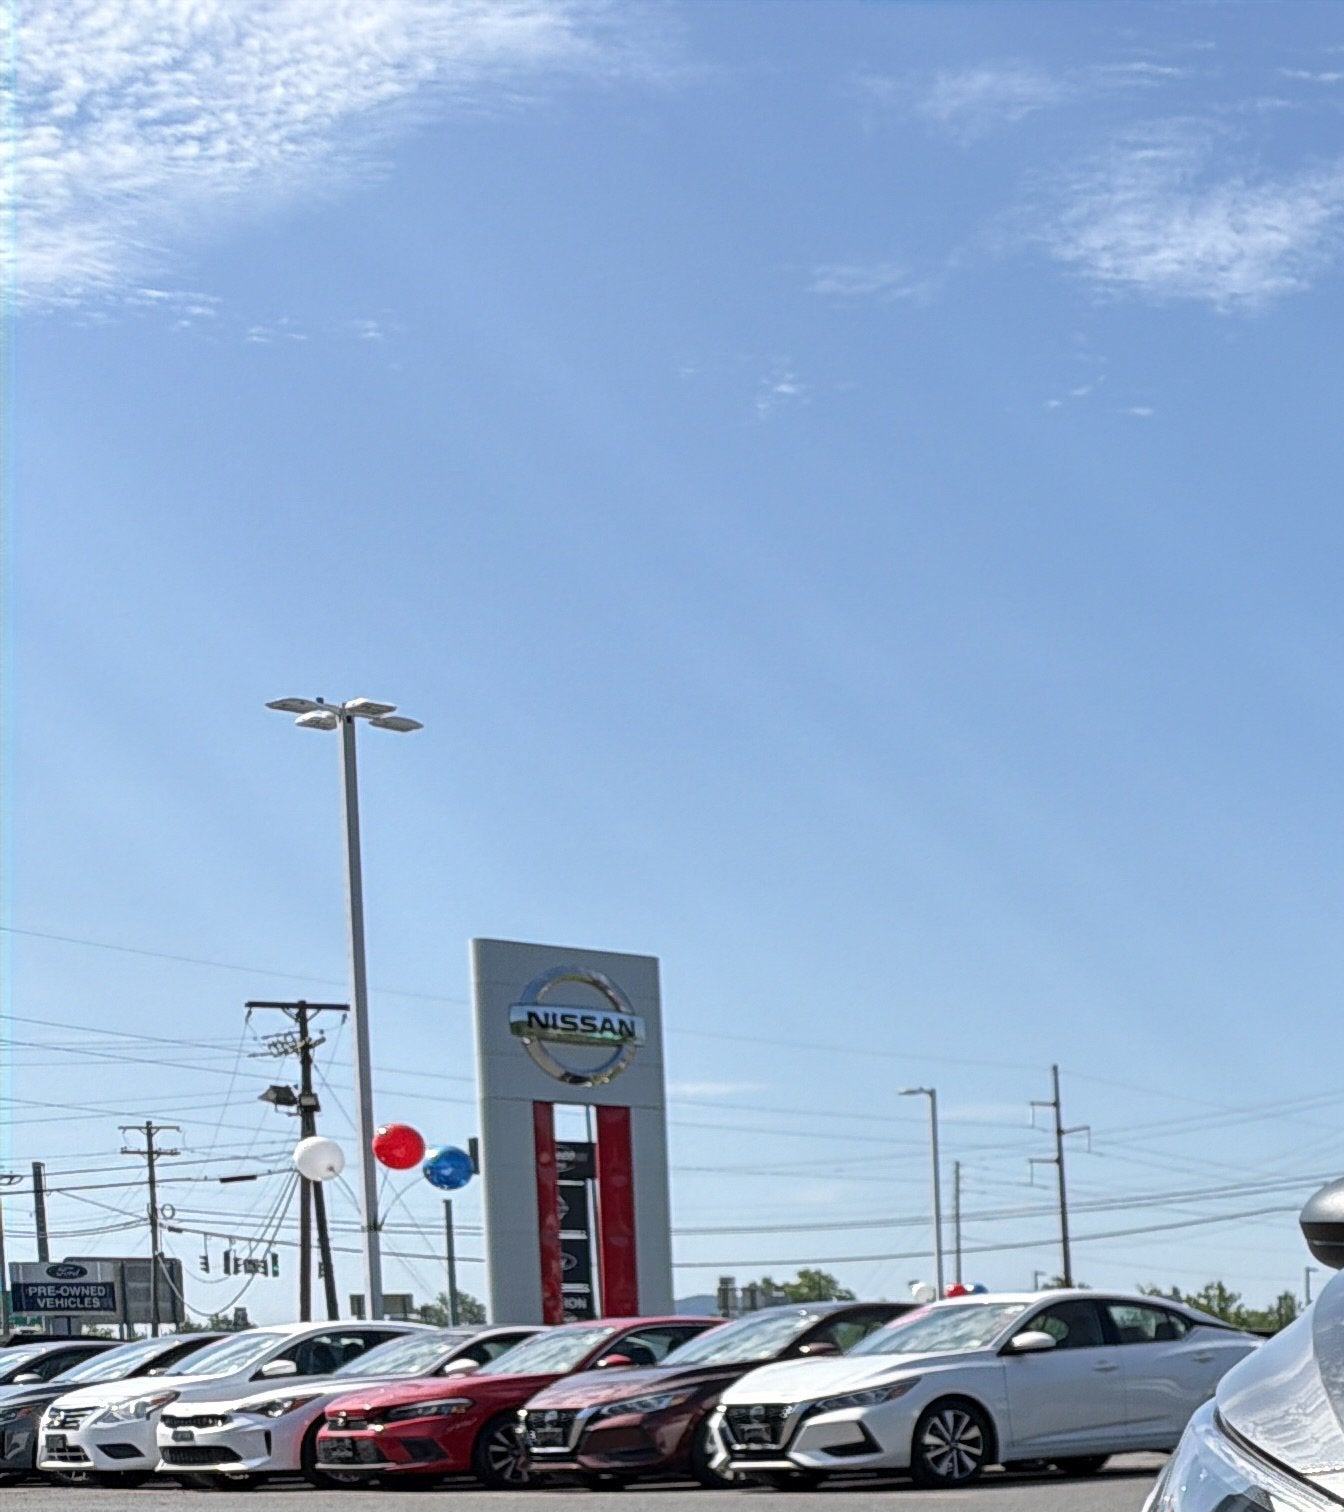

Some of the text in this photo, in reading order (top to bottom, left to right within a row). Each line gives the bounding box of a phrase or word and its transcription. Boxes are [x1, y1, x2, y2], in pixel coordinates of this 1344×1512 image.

[527, 1011, 636, 1037] NISSAN
[28, 1286, 105, 1297] PRE-OWNED
[37, 1297, 101, 1308] VEHICLES
